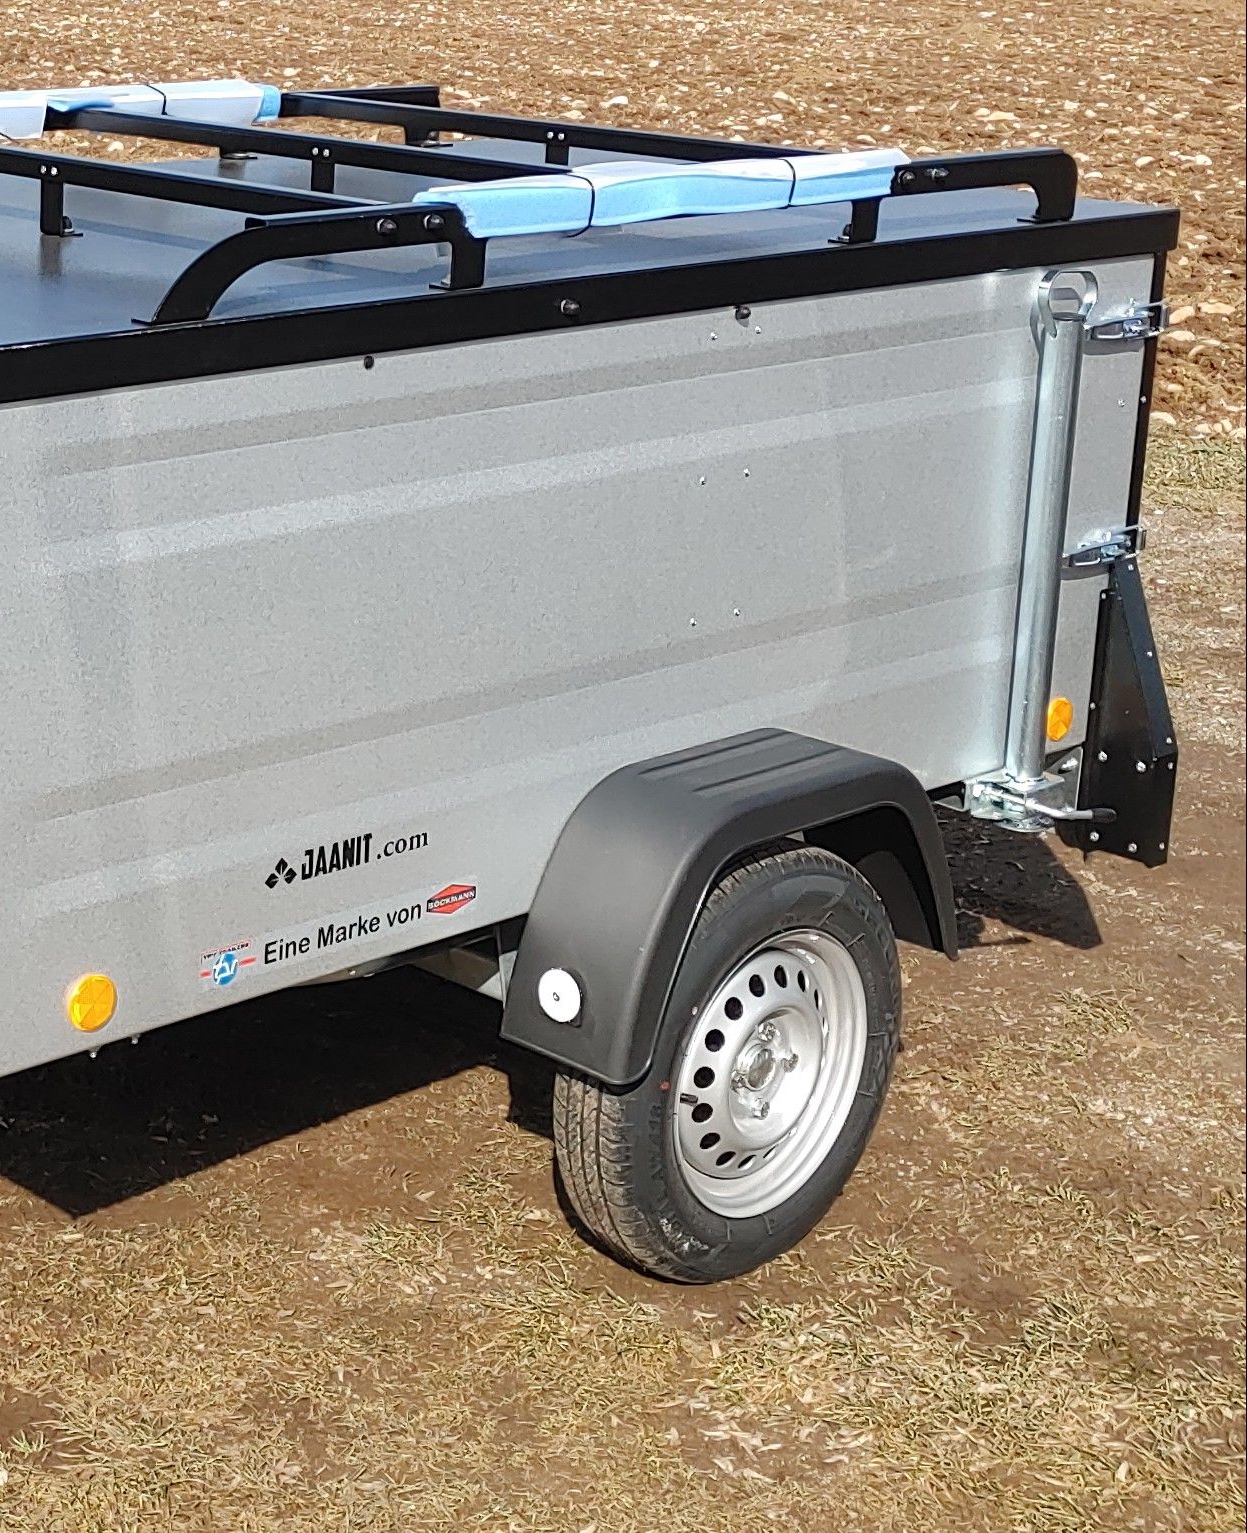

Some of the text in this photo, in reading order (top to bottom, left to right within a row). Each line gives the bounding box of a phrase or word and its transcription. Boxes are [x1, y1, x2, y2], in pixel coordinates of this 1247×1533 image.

[301, 832, 429, 881] JAANIT .com
[264, 937, 311, 965] Eine
[317, 915, 381, 949] Marke
[386, 903, 422, 928] von
